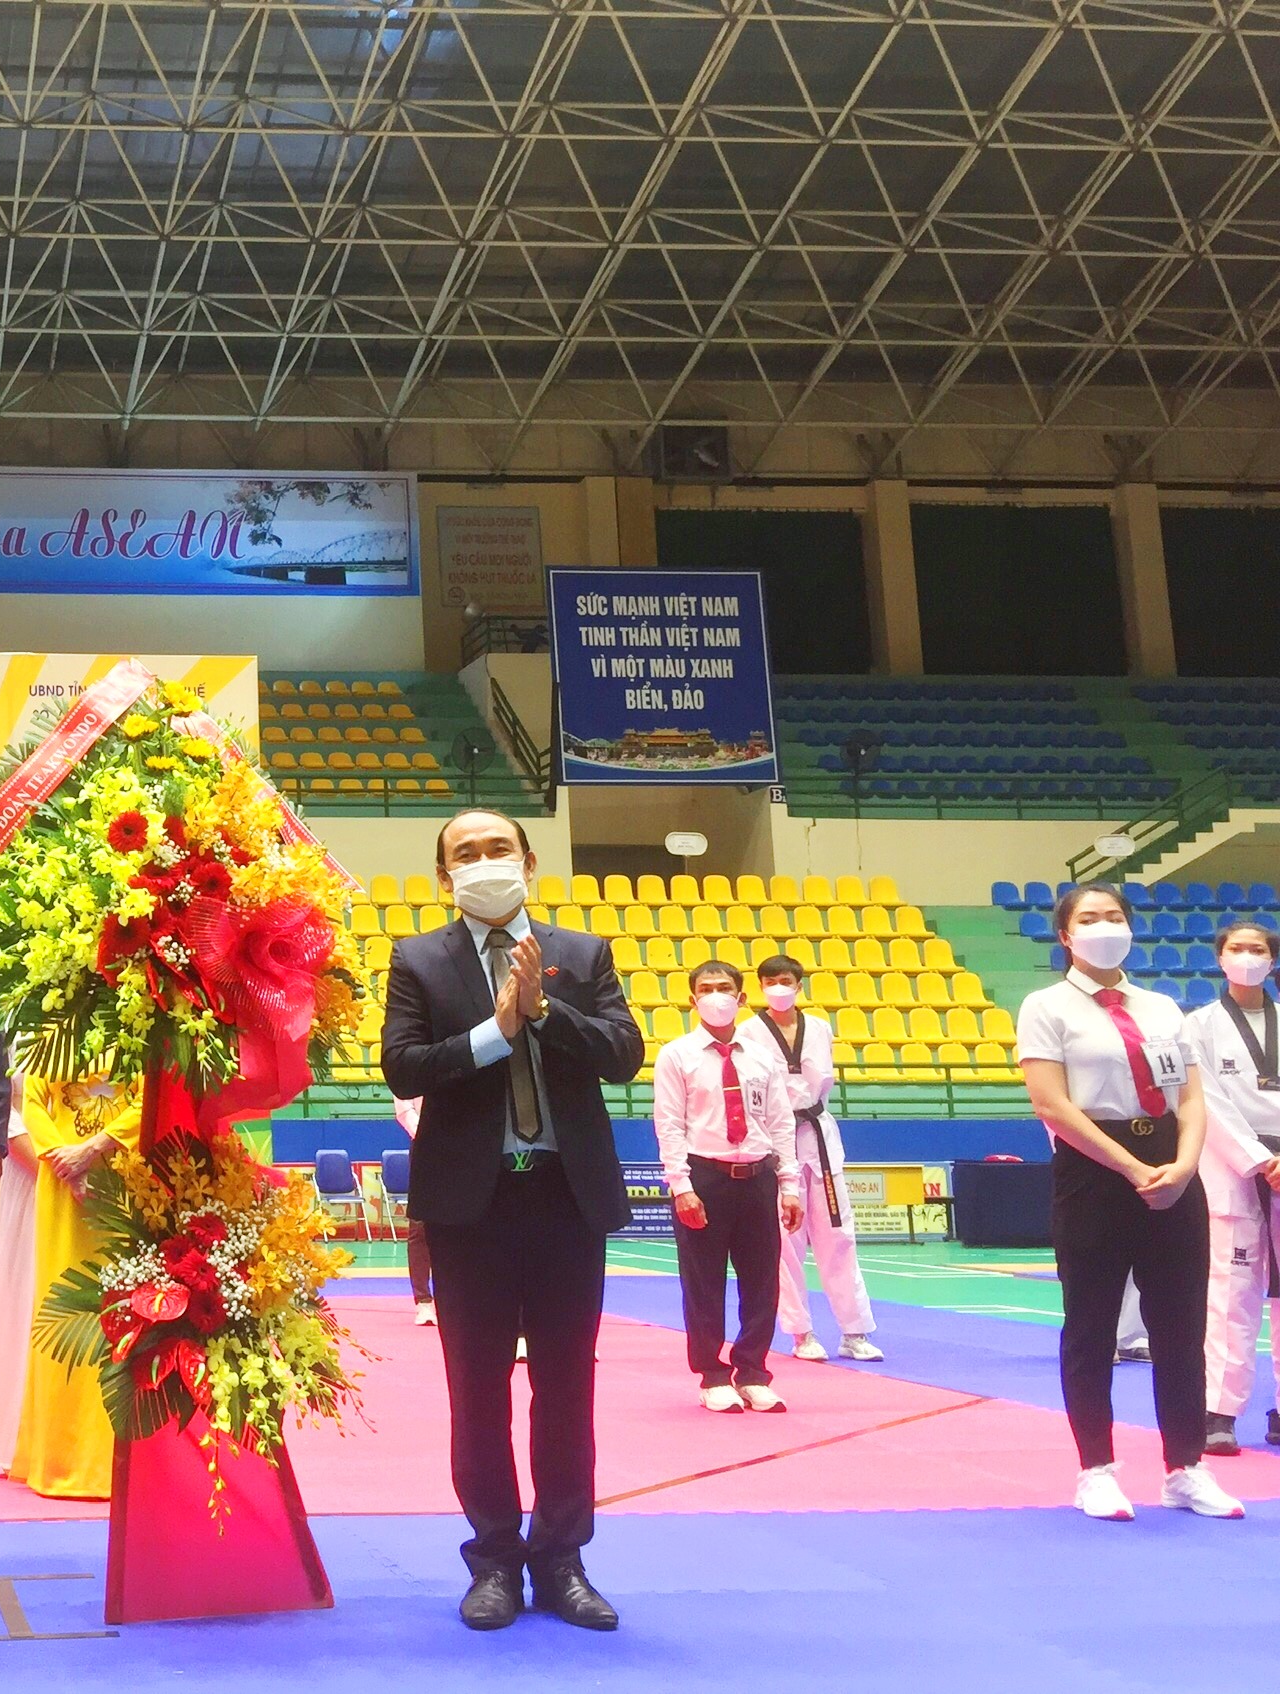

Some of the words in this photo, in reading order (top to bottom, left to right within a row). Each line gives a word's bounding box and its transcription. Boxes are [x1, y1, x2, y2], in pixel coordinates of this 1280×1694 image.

[39, 508, 248, 560] ASEAN
[576, 592, 608, 616] SỨC
[613, 595, 660, 620] MẠNH
[664, 592, 697, 620] VIỆT
[702, 596, 739, 617] NAM
[579, 627, 616, 646] TINH
[620, 620, 662, 647] THẦN
[665, 623, 698, 651] VIỆT
[703, 628, 741, 647] NAM
[591, 654, 607, 677] VÌ
[611, 654, 645, 682] MỘT
[650, 655, 686, 678] MÀU
[690, 658, 734, 678] XANH
[29, 685, 64, 697] UBND
[69, 680, 87, 697] TỈN
[625, 681, 668, 712] BIỂN,
[672, 683, 704, 710] ĐẢO
[869, 1182, 879, 1193] AN
